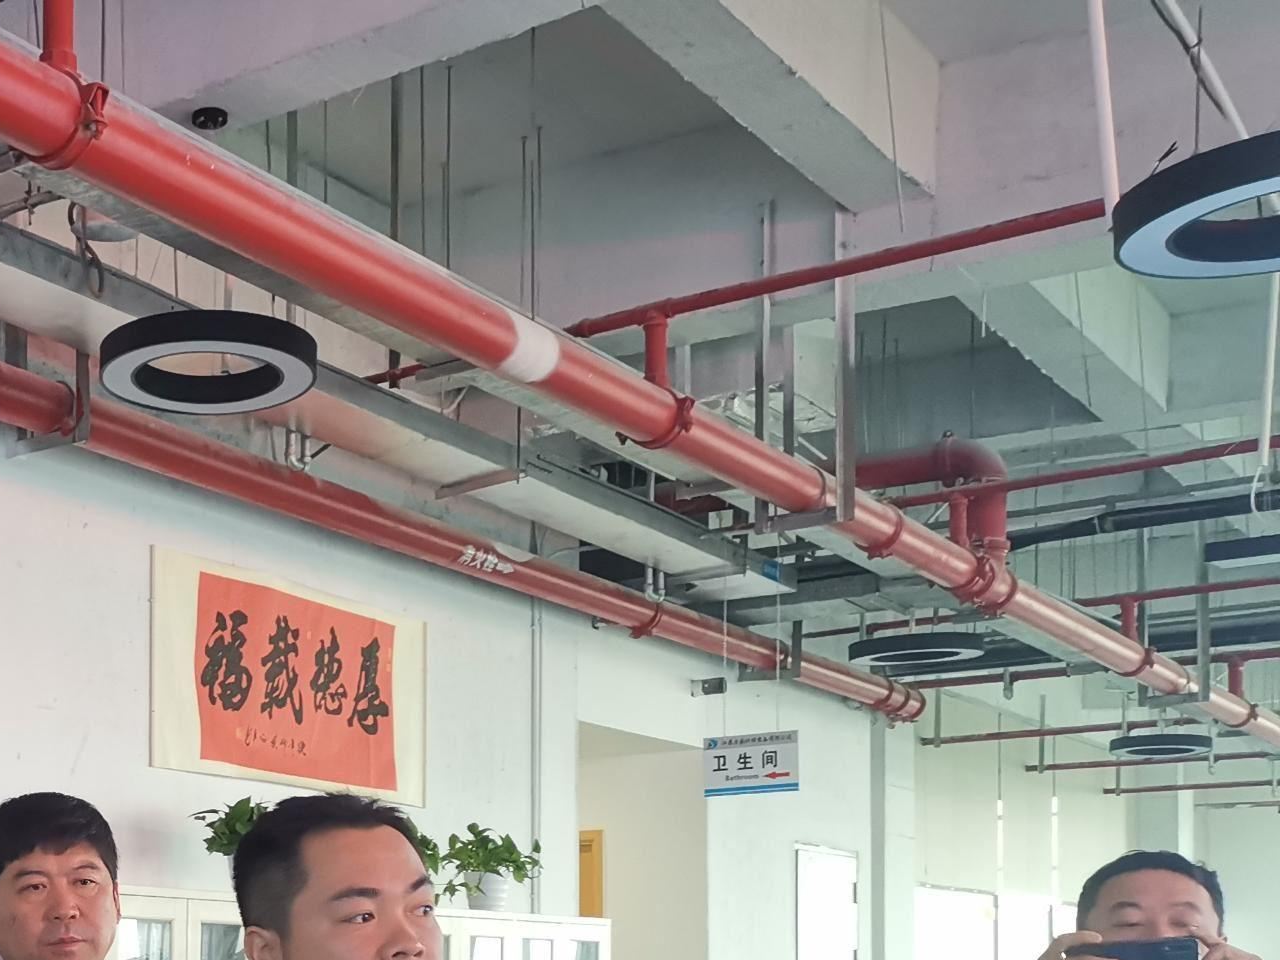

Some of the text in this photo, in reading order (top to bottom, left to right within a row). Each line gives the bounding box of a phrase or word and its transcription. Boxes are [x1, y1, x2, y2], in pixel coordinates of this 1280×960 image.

[712, 750, 778, 773] 卫生间
[725, 774, 760, 782] Bathroom
